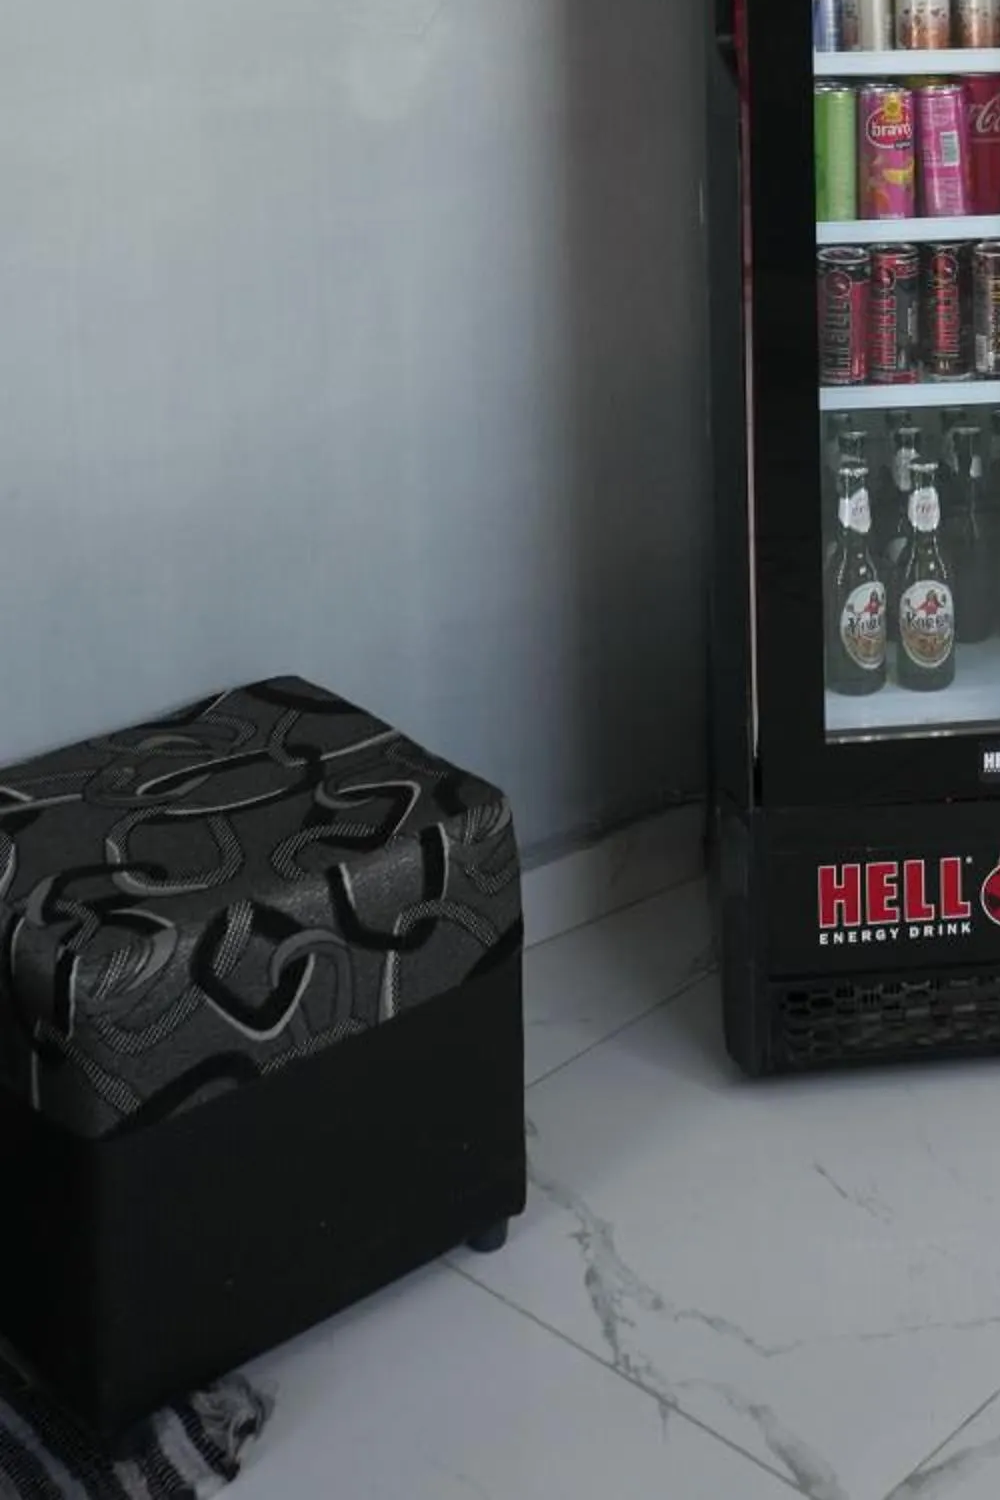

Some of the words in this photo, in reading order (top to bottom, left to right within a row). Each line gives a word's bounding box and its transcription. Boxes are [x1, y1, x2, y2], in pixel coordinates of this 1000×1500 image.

[817, 857, 971, 929] HELL
[819, 927, 899, 945] ENERGY
[909, 922, 971, 939] DRINK
